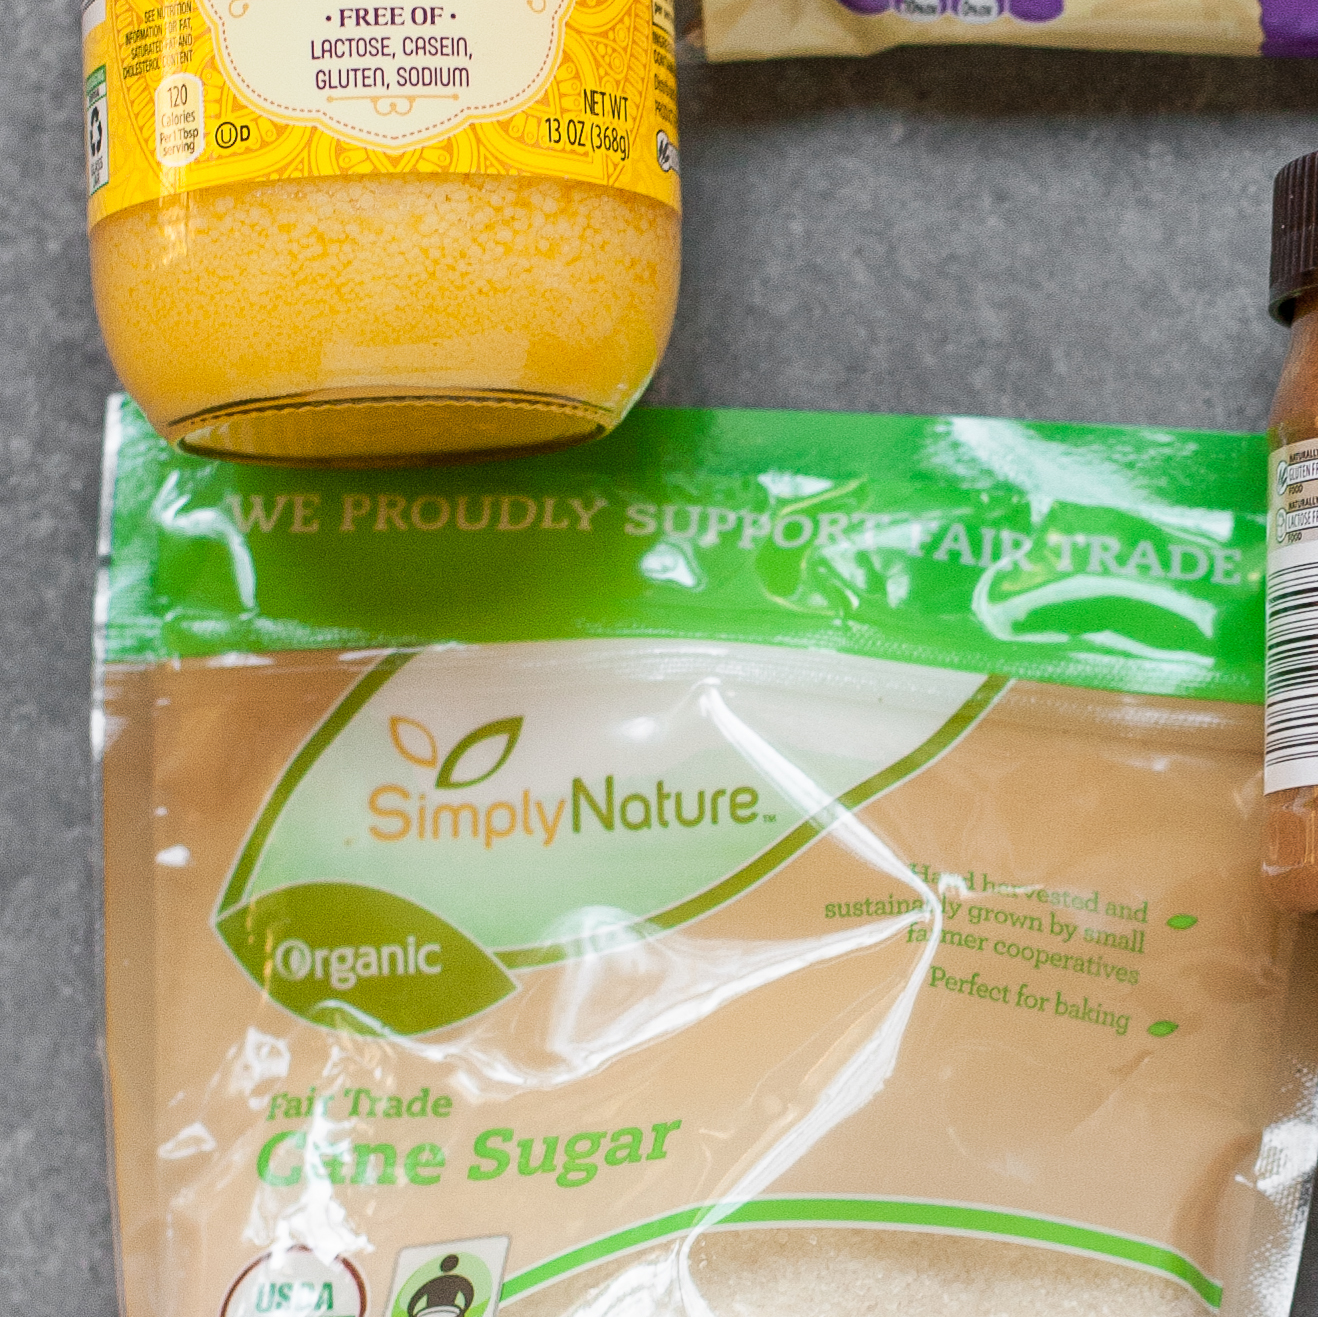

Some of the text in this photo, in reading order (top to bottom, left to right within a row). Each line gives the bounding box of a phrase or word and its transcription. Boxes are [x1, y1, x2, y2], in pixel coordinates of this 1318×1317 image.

[145, 9, 155, 23] SEE
[339, 6, 444, 27] FREE OF
[125, 23, 162, 45] INFORMATION
[179, 33, 192, 47] AND
[311, 36, 396, 61] LACTOSE,
[123, 60, 160, 80] CHOLESTEROL
[396, 66, 470, 88] SODIUM
[168, 84, 188, 107] 120
[584, 89, 628, 122] NET WT
[161, 109, 195, 128] Calories
[160, 127, 199, 144] Per Tbsp
[545, 118, 561, 143] 13
[567, 119, 586, 146] OZ
[591, 123, 630, 161] (368g)
[163, 140, 195, 156] serving
[1289, 466, 1311, 480] GLUTEN
[1288, 484, 1303, 494] FOOD
[1287, 513, 1311, 527] LACTOSE
[226, 493, 1243, 585] WE PROUDLY SUPPORT FAIR TRADE
[1287, 532, 1302, 542] FOOD
[368, 775, 760, 849] SimplyNature
[1105, 900, 1148, 923] and
[969, 904, 1145, 954] grown by small
[274, 937, 442, 991] Organic
[994, 939, 1140, 984] cooperatives
[928, 966, 1130, 1036] Perfect for baking
[265, 1086, 452, 1122] Fair Trade
[467, 1118, 683, 1188] Sugar
